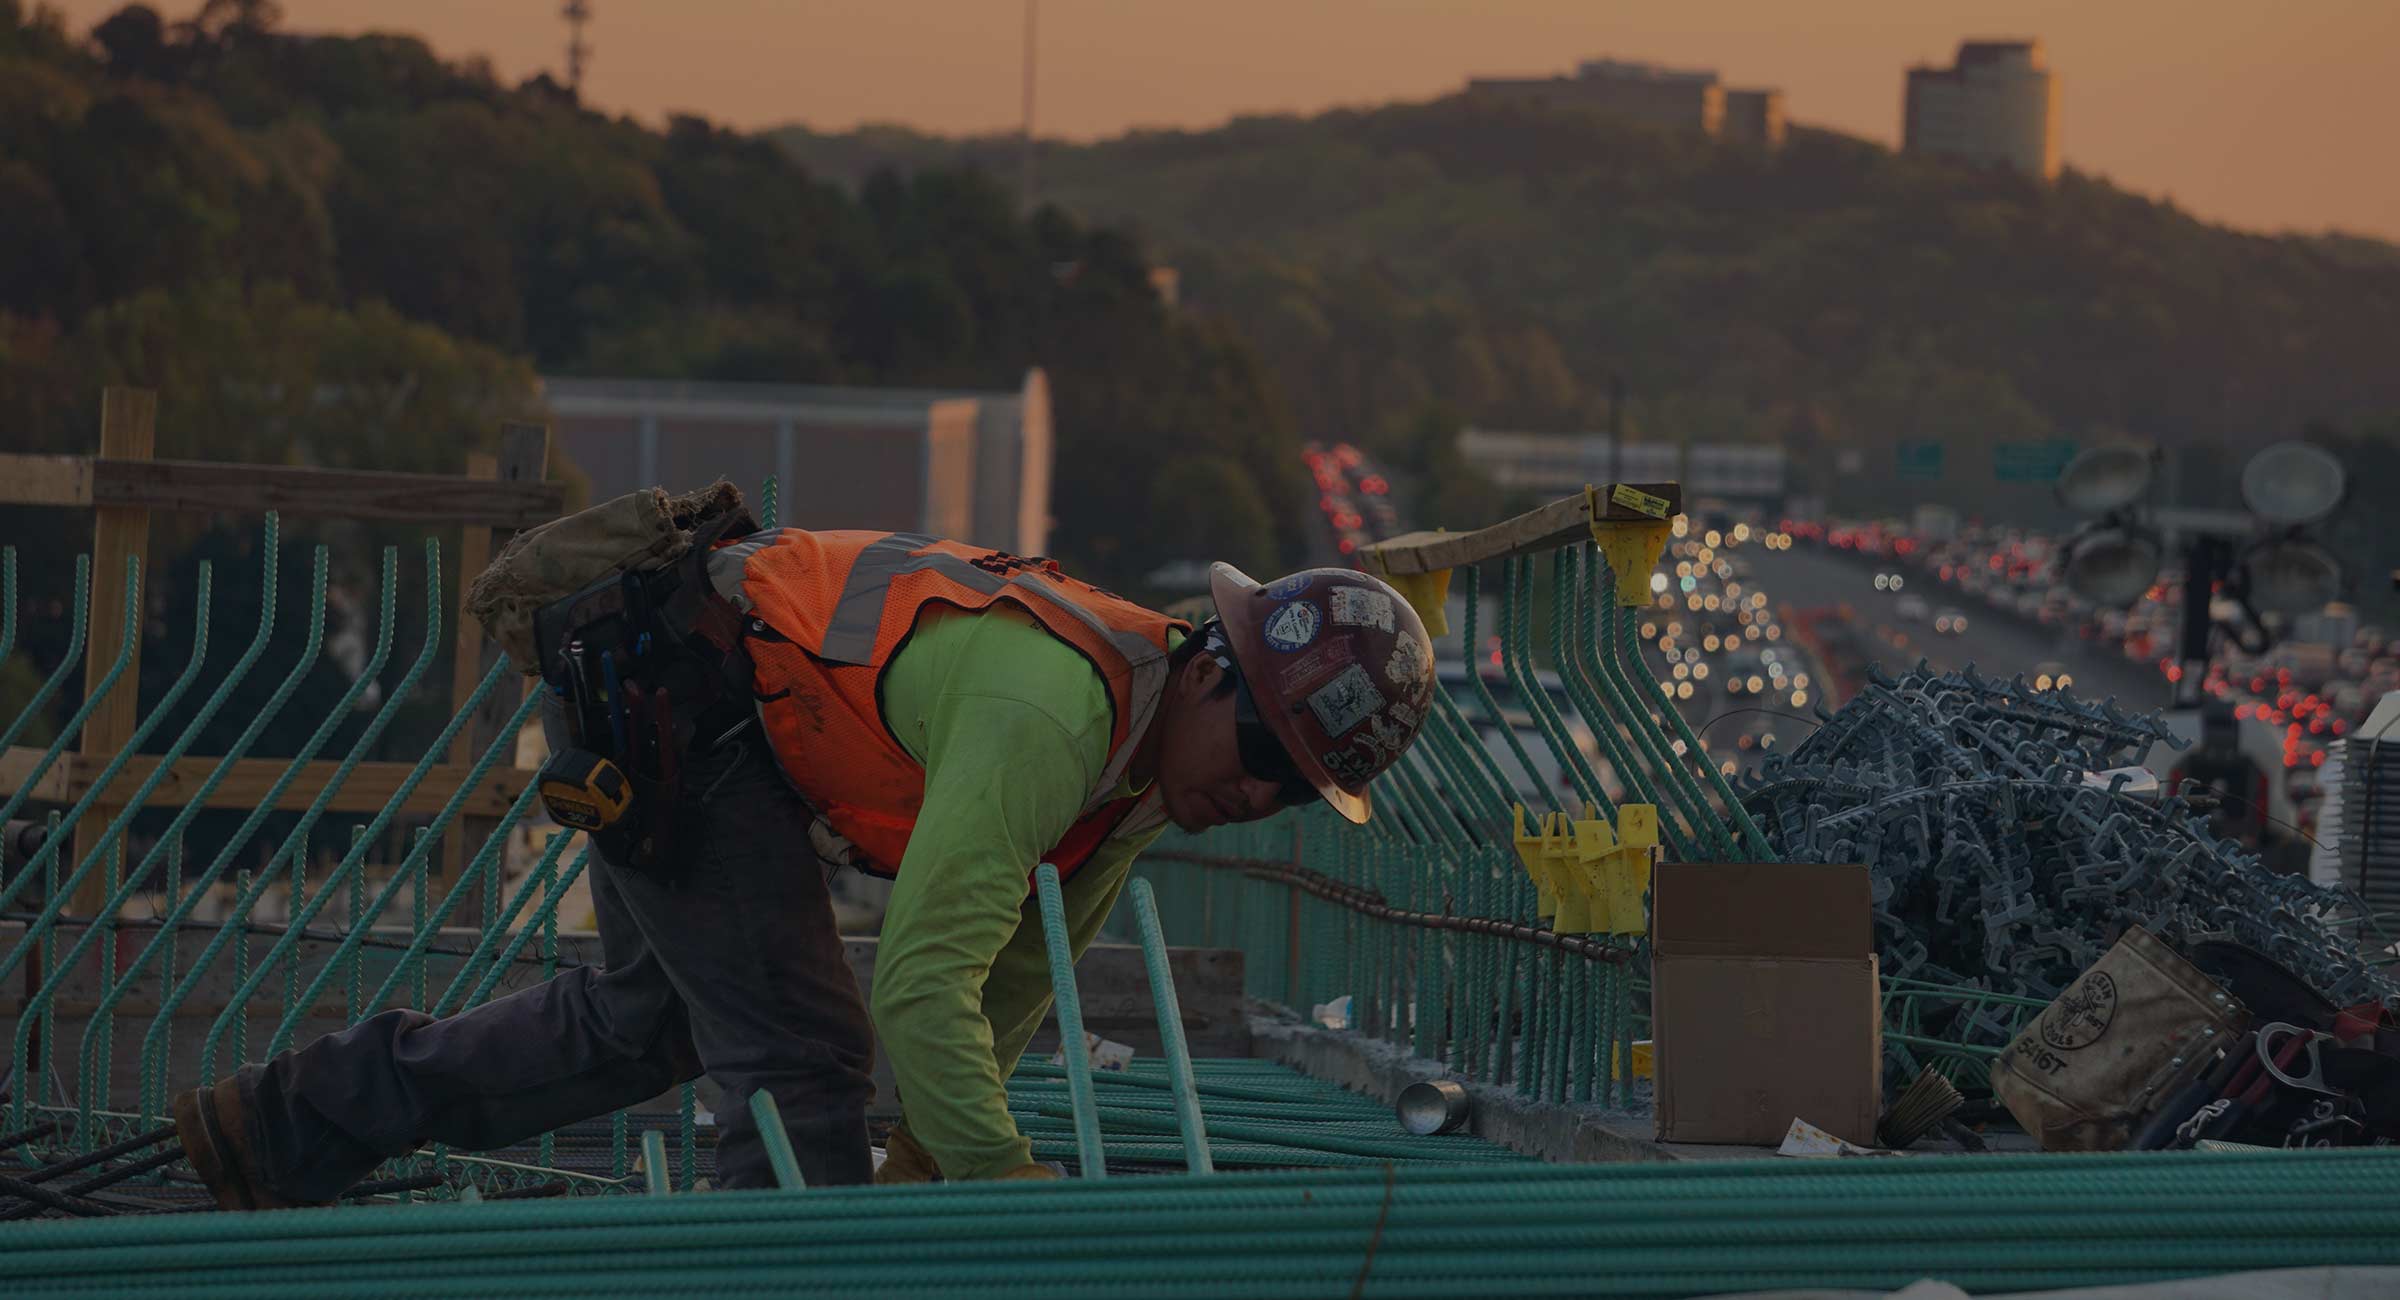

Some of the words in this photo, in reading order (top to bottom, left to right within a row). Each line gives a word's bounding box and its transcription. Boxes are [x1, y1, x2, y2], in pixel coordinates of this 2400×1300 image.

[2082, 974, 2112, 999] KLEIN
[2045, 1021, 2073, 1045] TOOLS
[2016, 1036, 2067, 1075] 5416T
